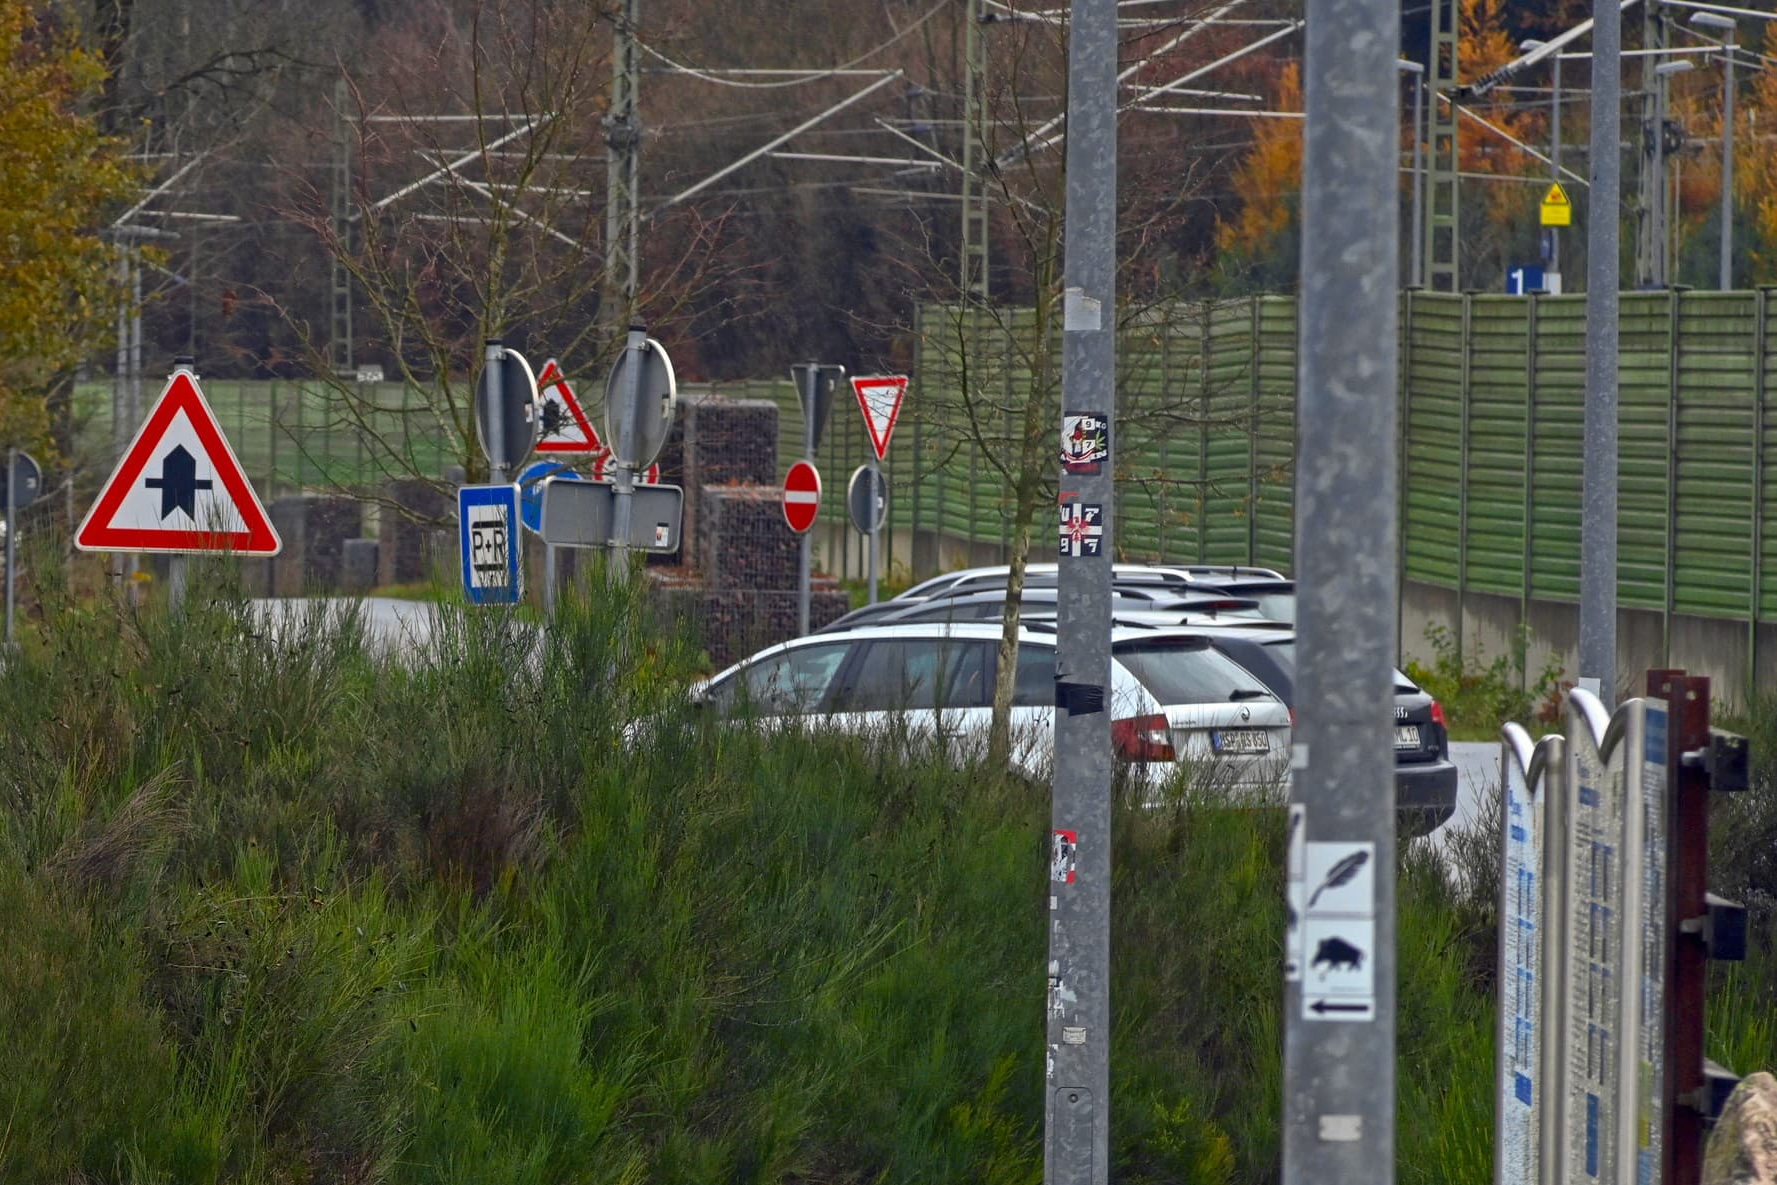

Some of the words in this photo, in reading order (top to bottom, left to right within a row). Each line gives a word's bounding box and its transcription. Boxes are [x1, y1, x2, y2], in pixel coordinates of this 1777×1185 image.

[1511, 268, 1524, 296] 1
[472, 530, 505, 563] P+R
[1084, 538, 1099, 553] 7
